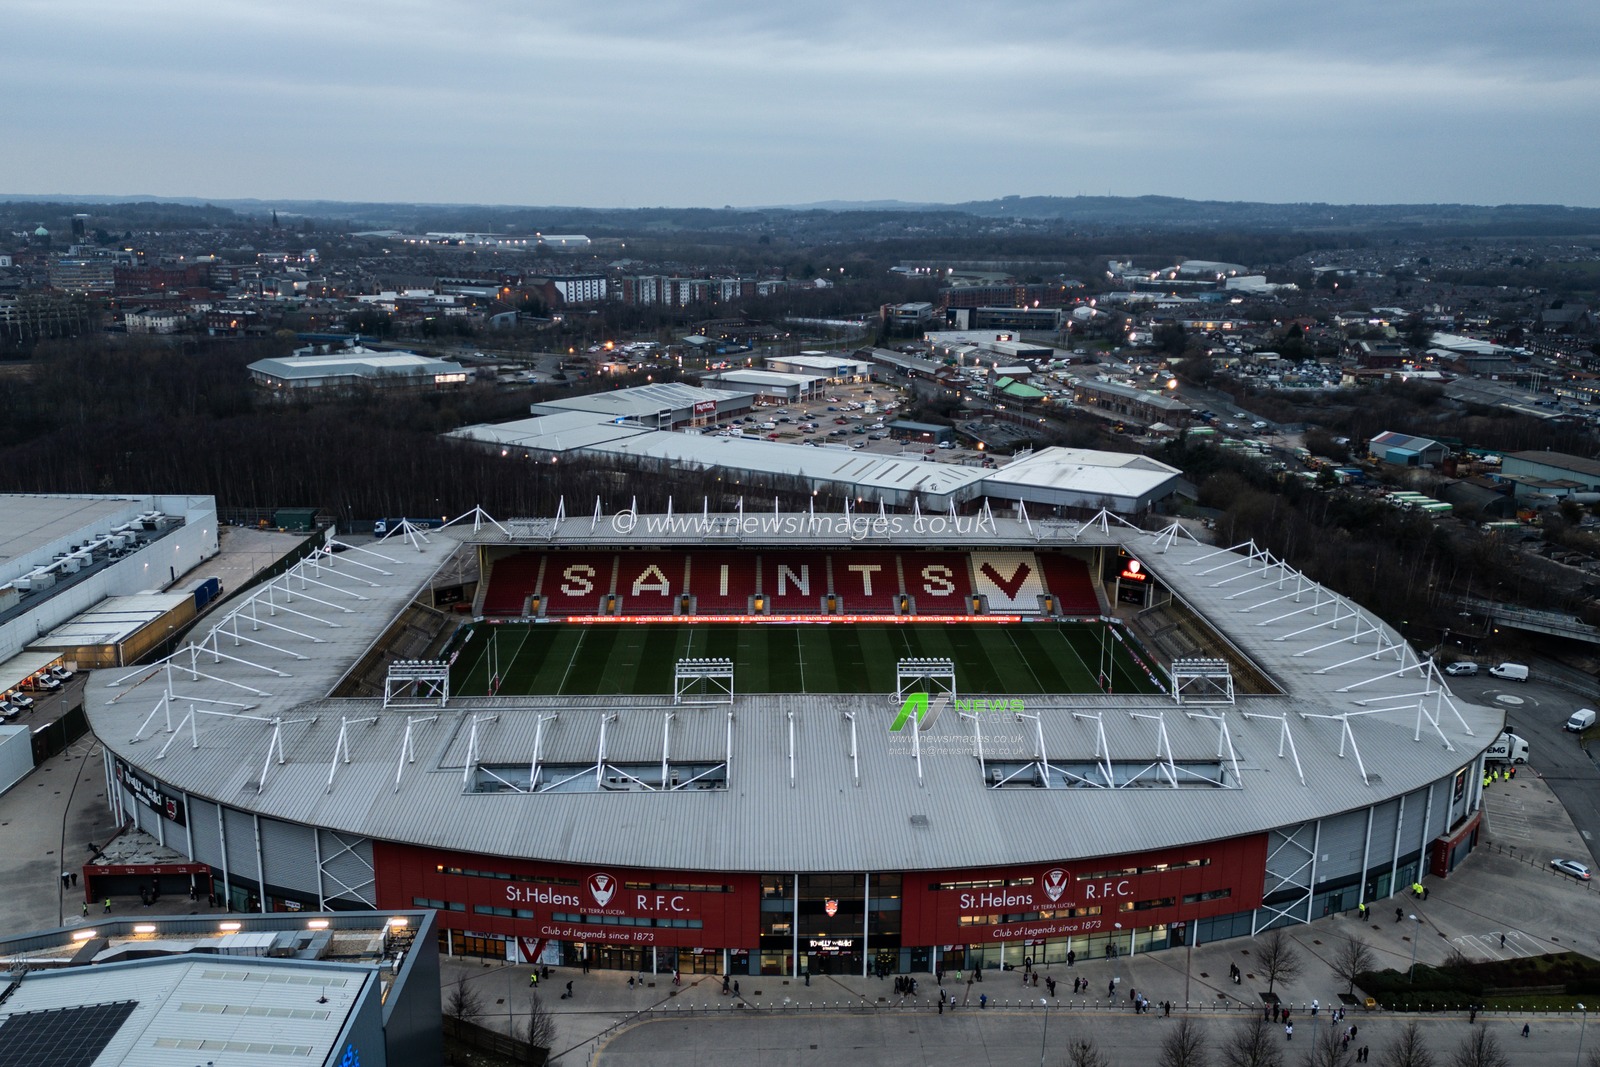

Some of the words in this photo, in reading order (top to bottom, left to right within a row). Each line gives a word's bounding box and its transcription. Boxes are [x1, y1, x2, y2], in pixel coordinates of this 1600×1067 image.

[1486, 746, 1506, 754] EMG
[1085, 881, 1135, 900] R.F.C.
[588, 907, 605, 915] TERRA
[637, 894, 691, 912] R.F.C.
[541, 925, 560, 936] Club
[563, 926, 572, 937] of
[573, 927, 607, 942] Legends
[608, 930, 631, 941] since
[633, 931, 655, 942] 1873
[992, 928, 1012, 938] Club
[1014, 926, 1024, 937] of
[1024, 924, 1056, 937] Legends
[1058, 923, 1079, 933] since
[1081, 919, 1102, 931] 1873
